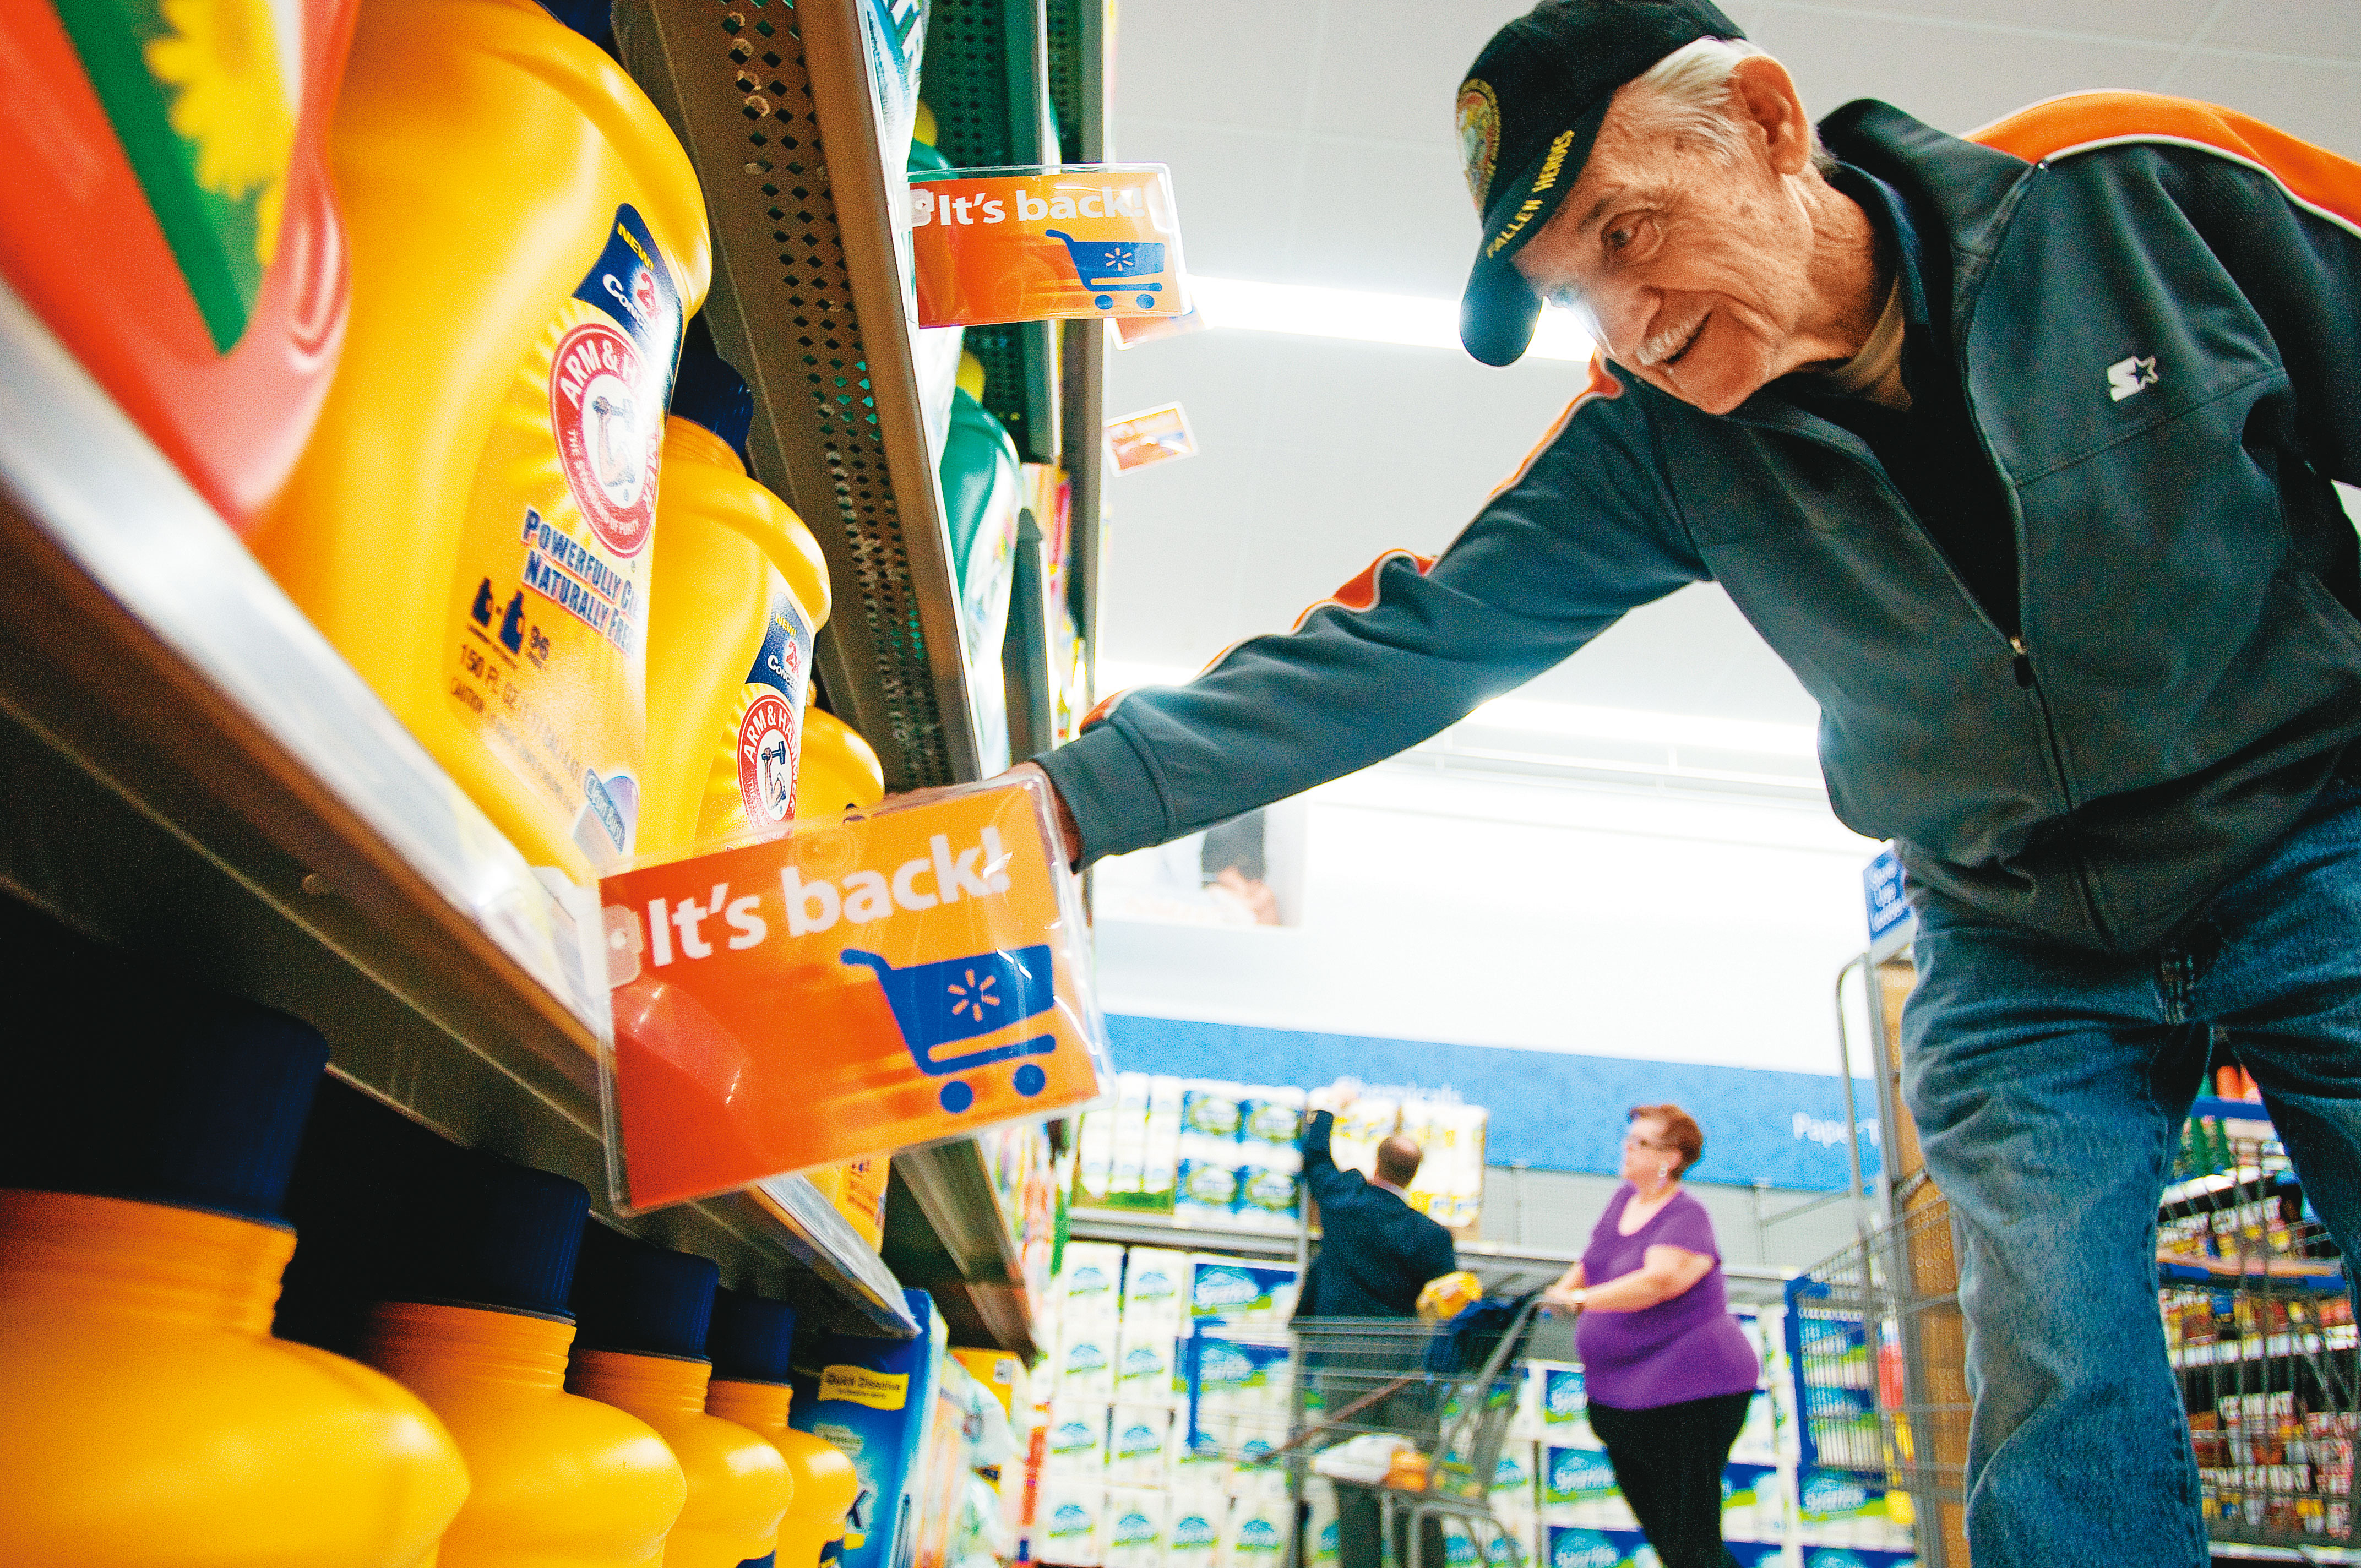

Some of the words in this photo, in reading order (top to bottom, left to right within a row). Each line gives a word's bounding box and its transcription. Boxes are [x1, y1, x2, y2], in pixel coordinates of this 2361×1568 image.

[939, 193, 1006, 226] It's
[1016, 186, 1145, 221] back!
[561, 340, 602, 410] ARM
[603, 340, 619, 373] &
[523, 509, 621, 600] POWERFULLY
[524, 549, 609, 630] NATURALLY
[744, 707, 767, 764] ARM
[768, 705, 776, 726] &
[648, 884, 768, 967] It's
[780, 826, 1011, 937] back!
